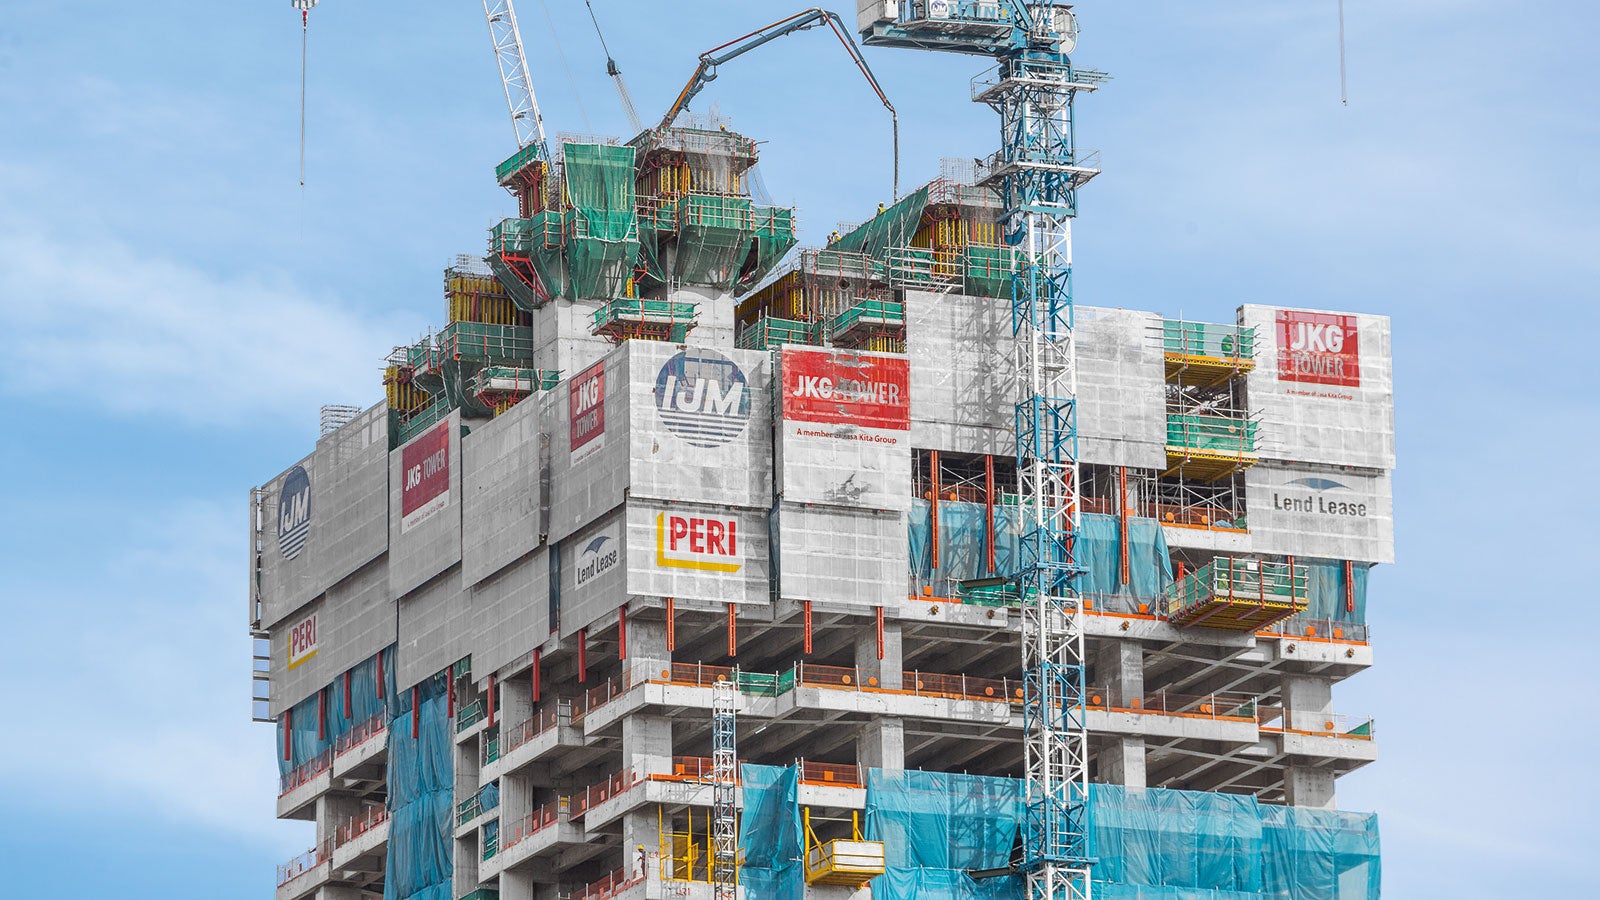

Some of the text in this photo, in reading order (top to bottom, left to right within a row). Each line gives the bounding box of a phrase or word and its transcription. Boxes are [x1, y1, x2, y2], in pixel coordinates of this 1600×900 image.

[1291, 322, 1344, 353] JKG
[1292, 353, 1344, 377] TOWER
[576, 376, 599, 415] JKG
[661, 375, 744, 416] IJM
[792, 375, 833, 399] JKG
[576, 408, 598, 438] TOWER
[796, 428, 803, 436] A
[803, 429, 833, 438] member
[859, 433, 873, 442] Kita
[874, 434, 897, 445] Group
[405, 448, 446, 492] JKG TOWER
[279, 486, 310, 537] IJM
[1273, 493, 1367, 517] Lend Lease
[669, 515, 737, 556] PERI
[577, 549, 617, 585] Lend Lease
[291, 615, 317, 657] PERI
